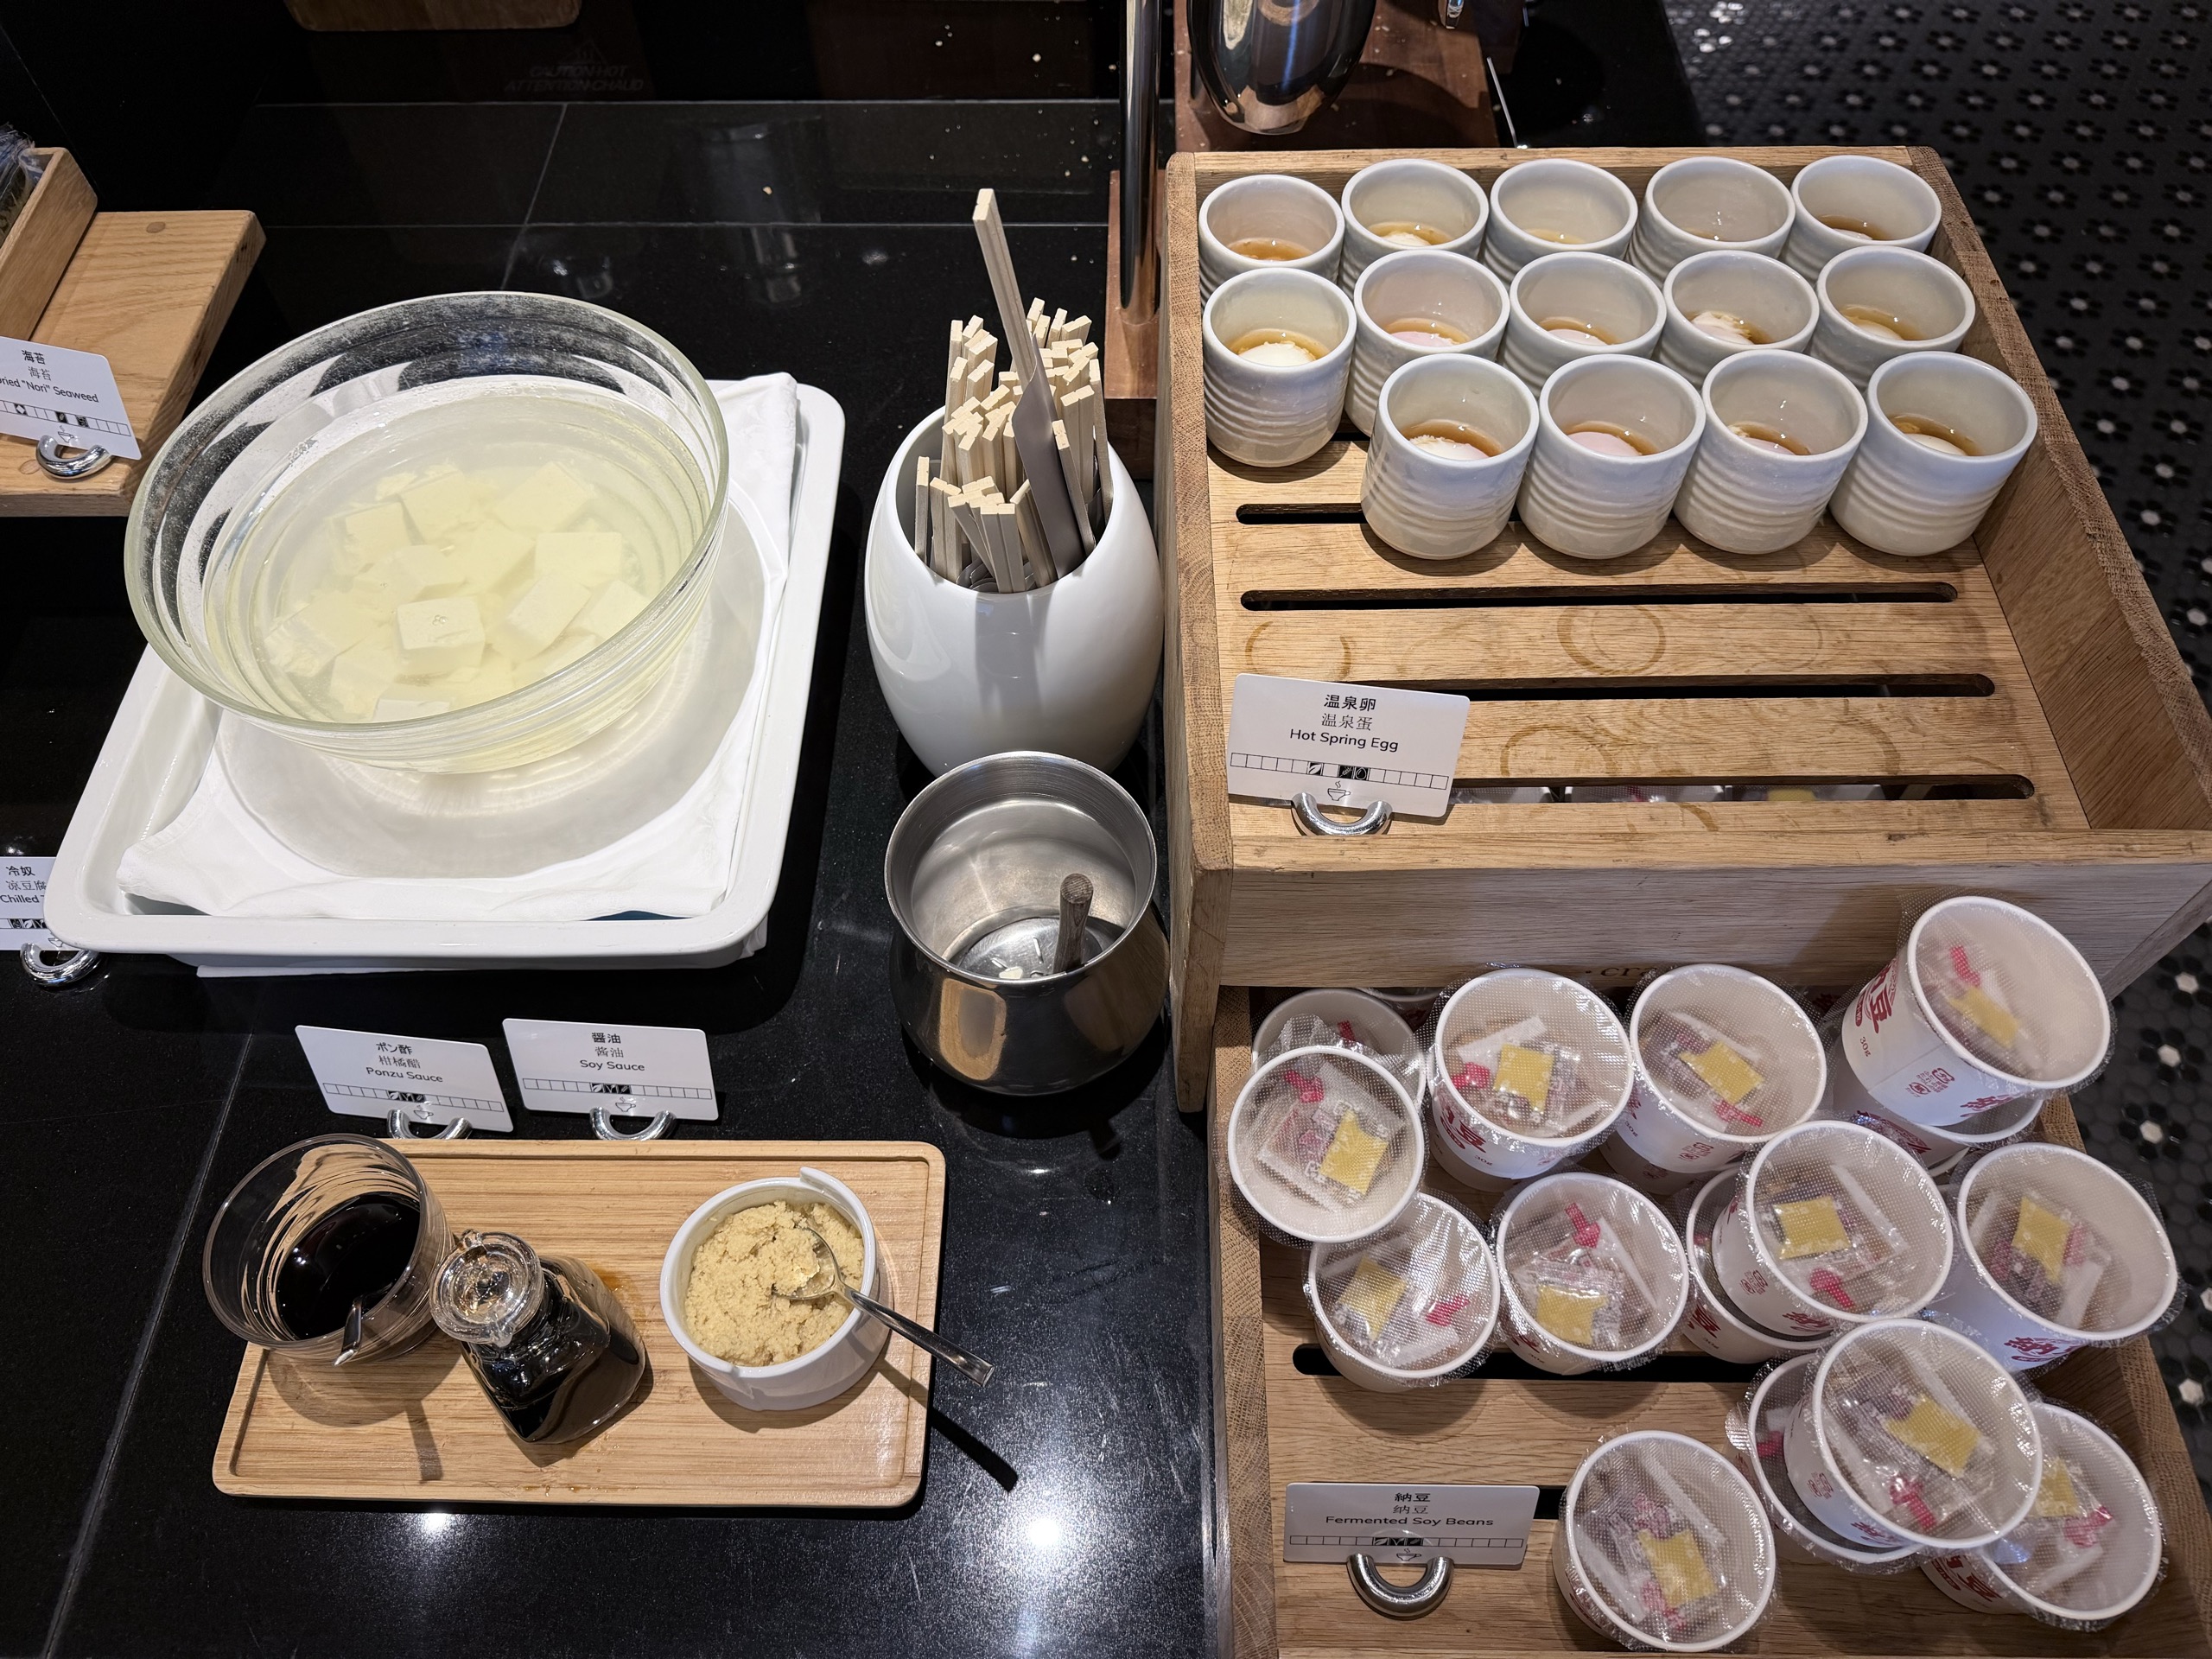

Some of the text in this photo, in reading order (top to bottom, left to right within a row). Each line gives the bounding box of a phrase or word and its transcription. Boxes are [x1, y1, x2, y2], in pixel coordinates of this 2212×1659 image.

[22, 350, 46, 365] 海苔
[28, 366, 52, 381] 海苔
[22, 379, 50, 393] "Nori"
[53, 386, 99, 403] Seaweed
[1324, 694, 1376, 711] 温泉卵
[1321, 713, 1373, 731] 温泉蛋
[1290, 728, 1398, 753] Hot Spring Egg
[6, 865, 35, 876] 冷奴
[0, 894, 40, 904] Chilled
[376, 1041, 412, 1055] ポン酢
[1859, 1036, 1871, 1057] 30g
[580, 1059, 645, 1071] Soy Sauce
[365, 1066, 443, 1083] Ponzu Sauce
[1395, 1492, 1431, 1502] 納豆
[1392, 1504, 1428, 1514] 纳豆
[1325, 1516, 1494, 1527] Fermented Soy Beans
